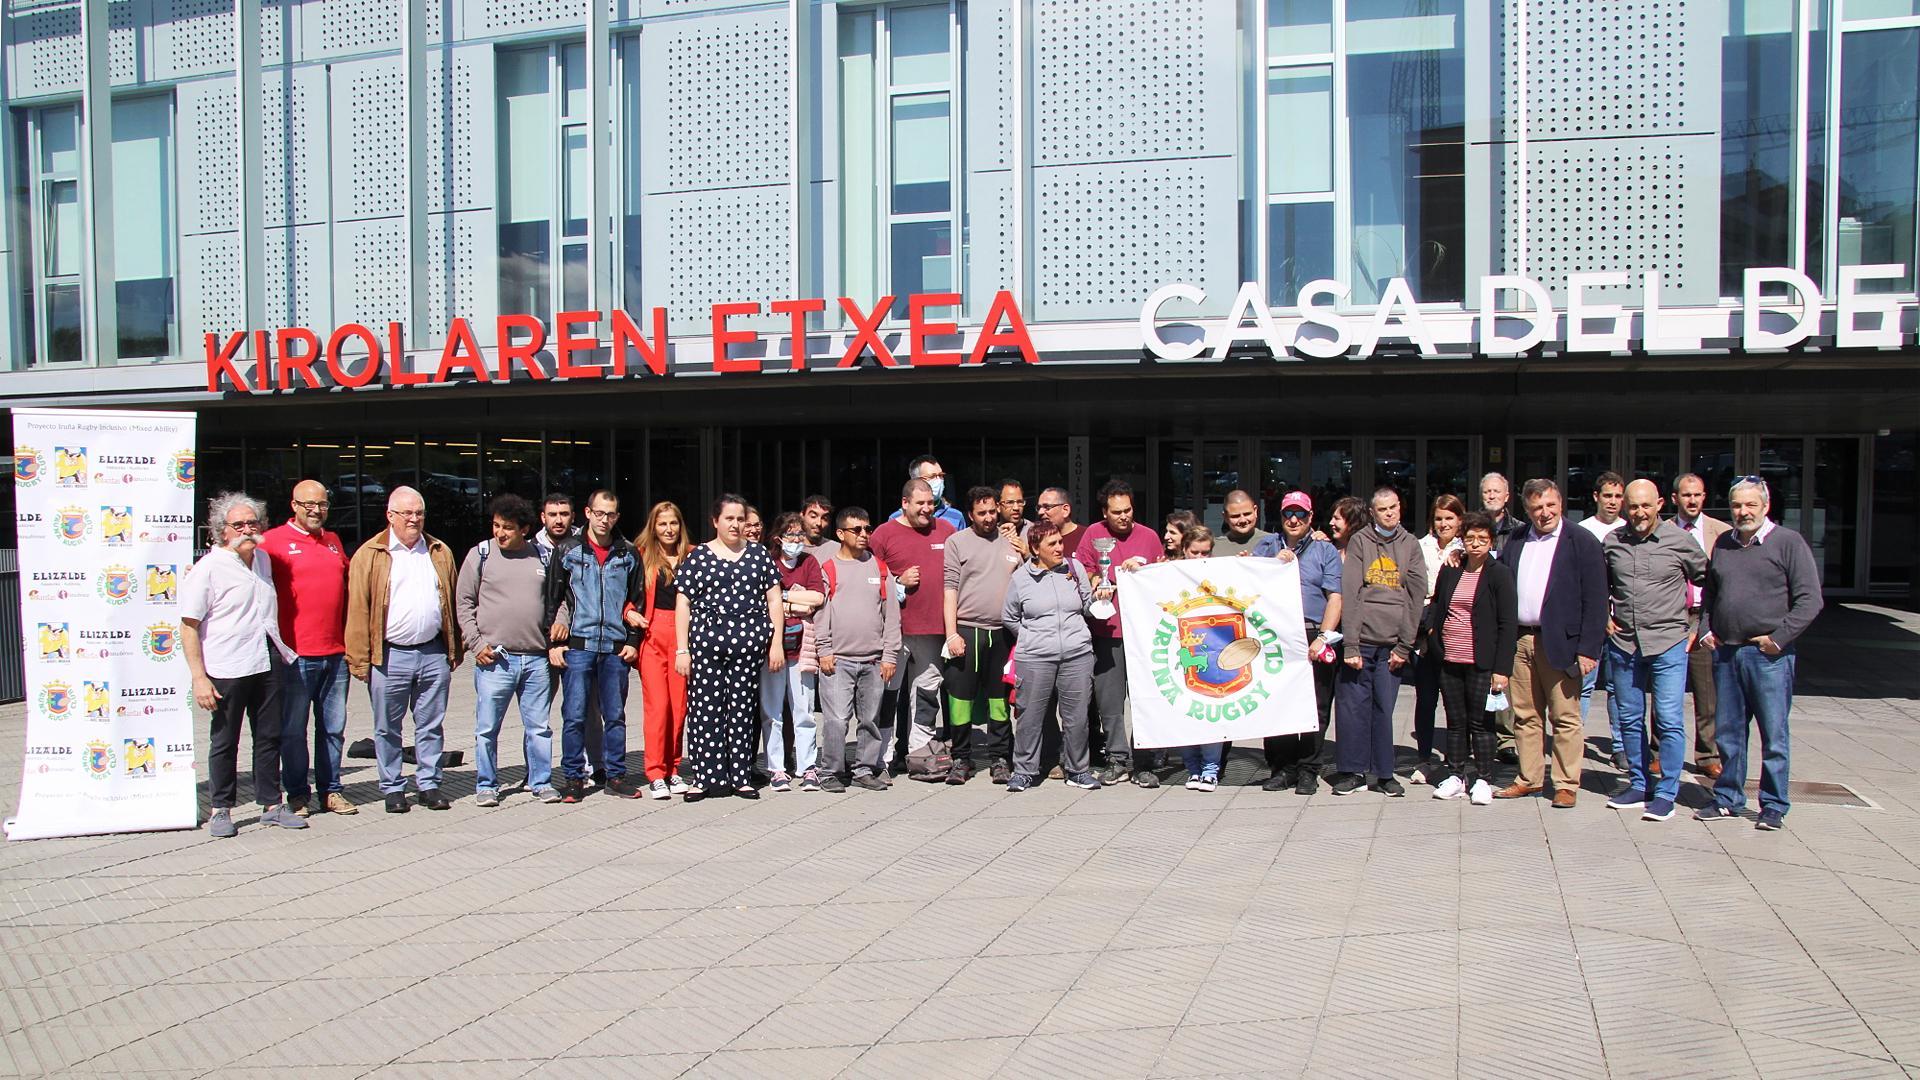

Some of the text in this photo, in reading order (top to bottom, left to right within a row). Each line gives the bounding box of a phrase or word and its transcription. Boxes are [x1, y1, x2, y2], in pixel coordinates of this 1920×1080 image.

[1139, 263, 1905, 361] CASA DEL DE
[204, 290, 1041, 393] KIROLAREN ETXEA
[27, 422, 57, 431] Proyecto
[77, 423, 98, 433] Rugby
[99, 423, 128, 432] Inclusivo
[128, 424, 152, 433] (Mixed
[153, 425, 179, 435] Ability)
[98, 455, 157, 465] ELIZALDE
[33, 572, 87, 581] ELIZALDE
[80, 630, 131, 639] ELIZALDE
[1186, 680, 1271, 723] RUGBY
[1247, 610, 1284, 675] CLUB
[121, 687, 177, 697] ELIZALDE
